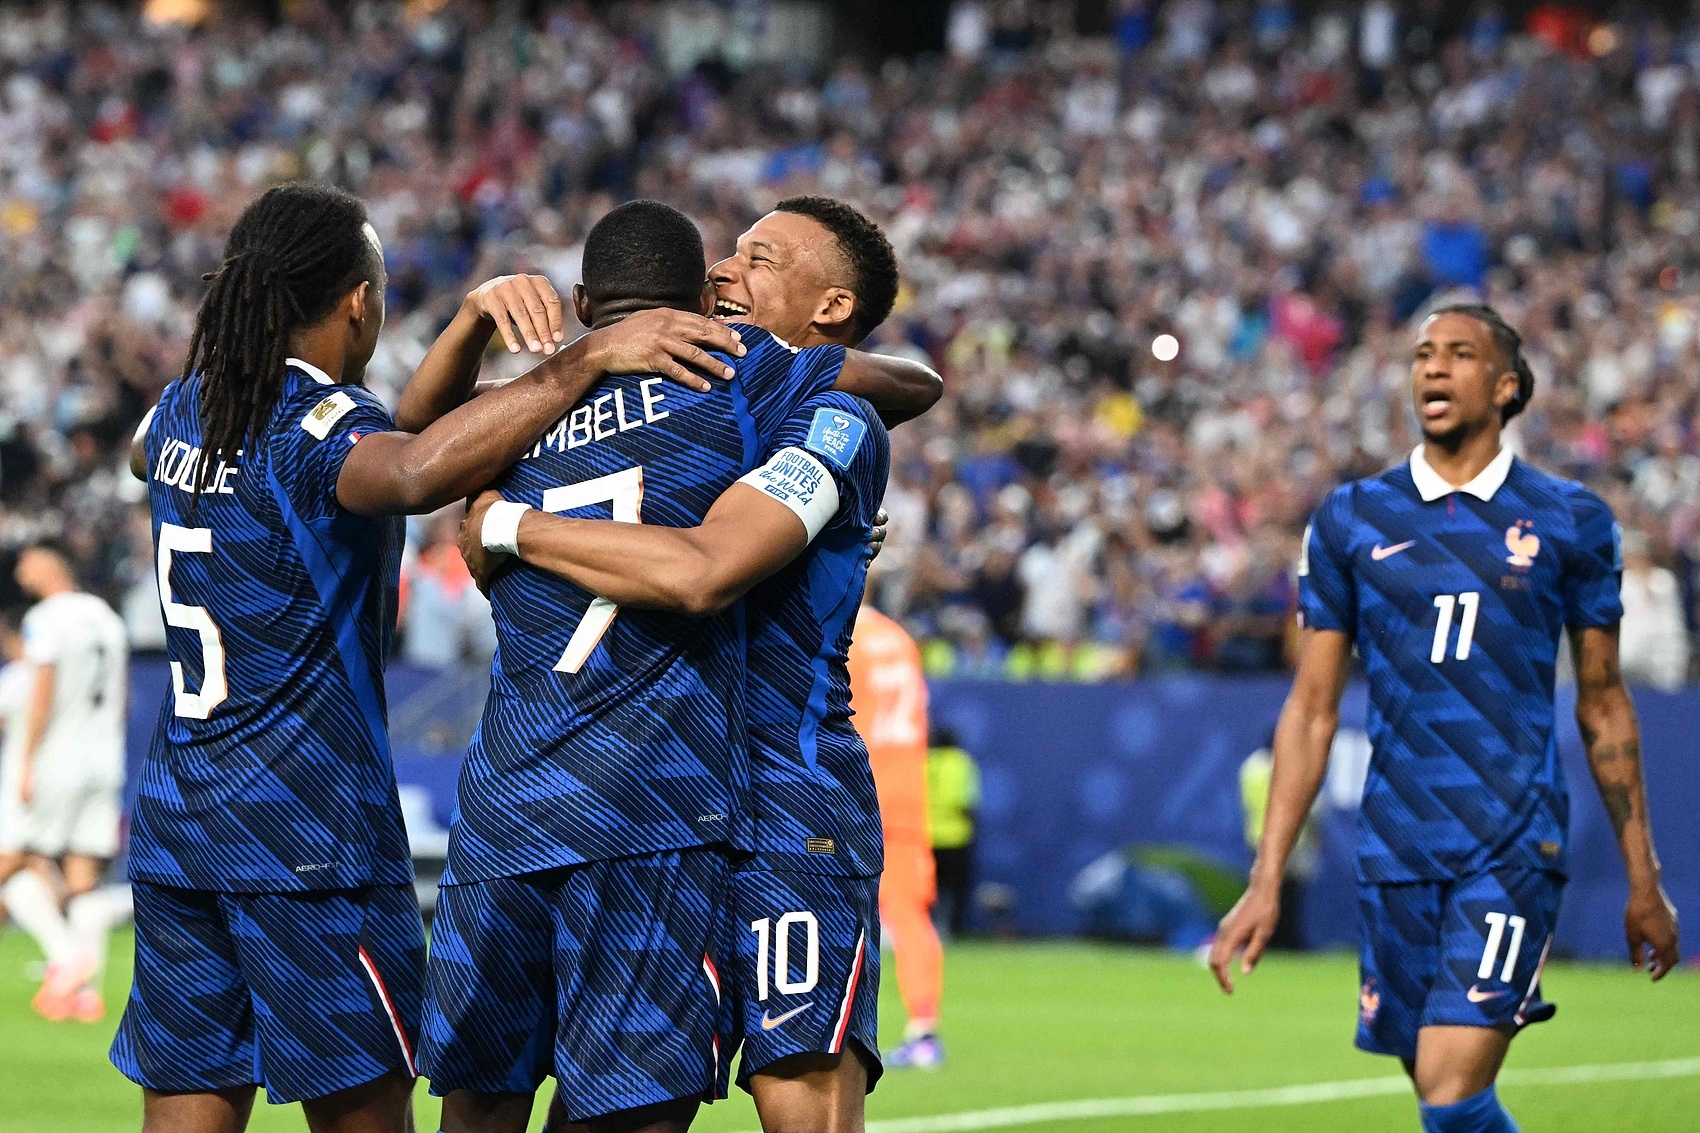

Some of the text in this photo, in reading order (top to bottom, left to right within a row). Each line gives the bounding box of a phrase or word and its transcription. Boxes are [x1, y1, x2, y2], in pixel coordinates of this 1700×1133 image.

[521, 377, 670, 460] MBELE
[821, 434, 846, 453] PEACE
[758, 470, 813, 506] the World
[765, 485, 790, 501] FIFA
[771, 460, 818, 495] UNITES
[780, 451, 824, 485] FOOTBALL
[542, 465, 645, 675] 7
[157, 521, 228, 720] 5
[1430, 591, 1480, 664] 11
[751, 911, 820, 1002] 10
[1477, 911, 1527, 984] 11
